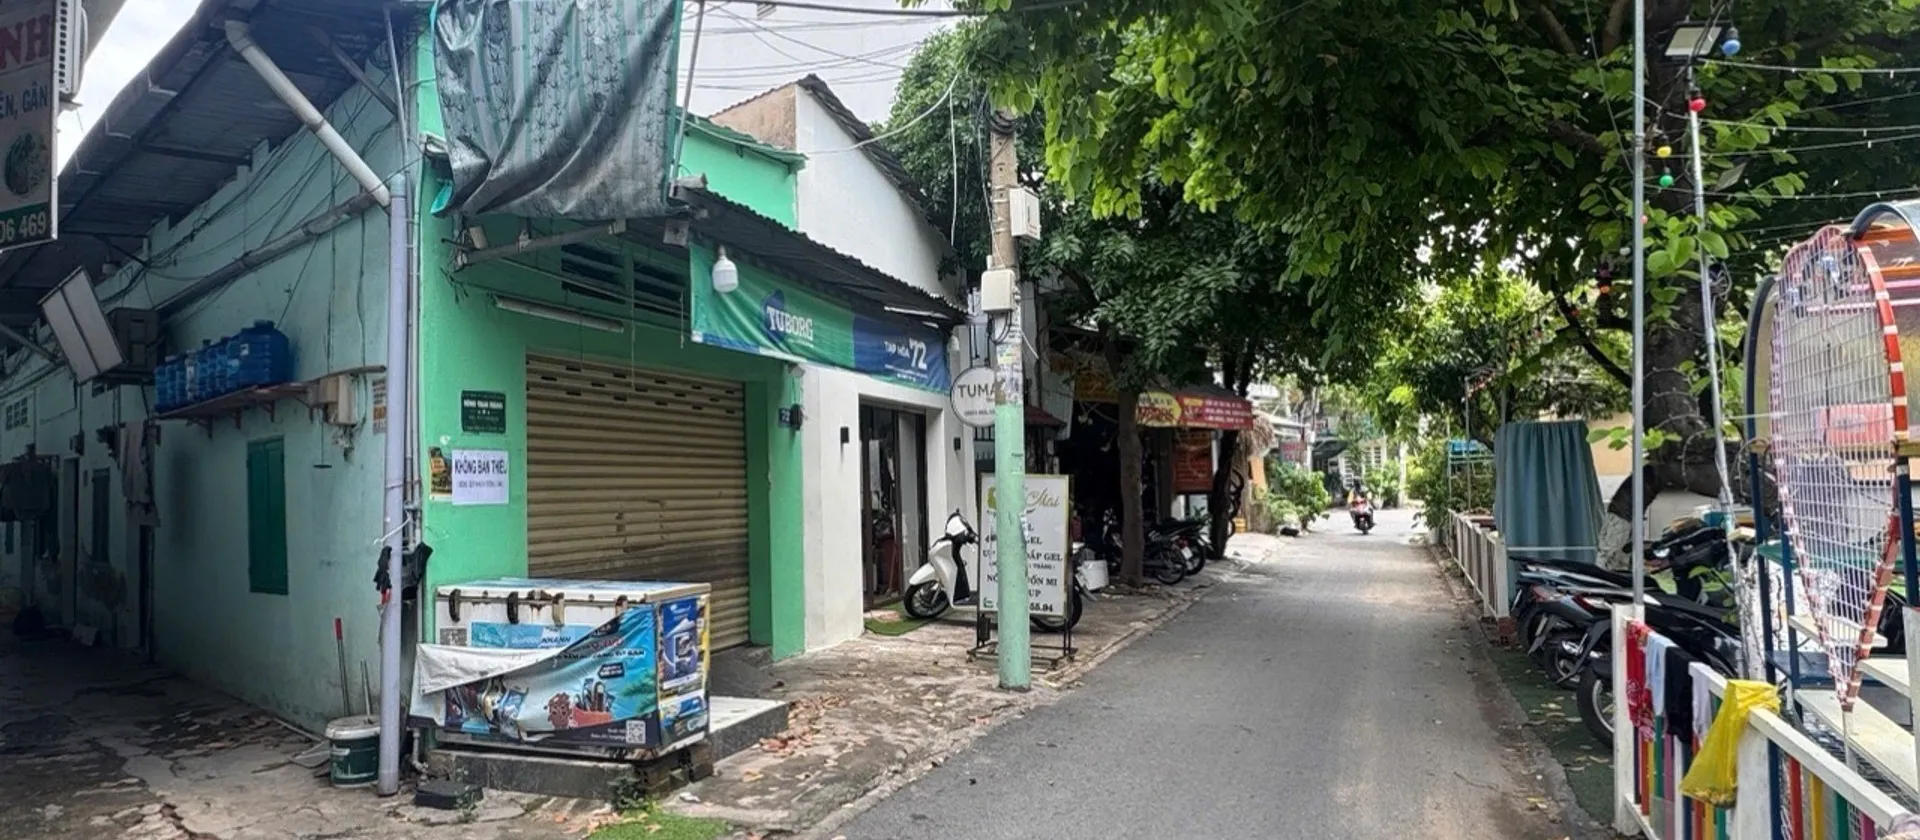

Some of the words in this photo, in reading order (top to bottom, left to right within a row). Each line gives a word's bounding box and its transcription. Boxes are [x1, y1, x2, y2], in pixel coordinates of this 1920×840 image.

[19, 211, 46, 238] 469
[766, 305, 814, 341] TUBORG
[909, 338, 927, 370] 72
[1044, 552, 1063, 562] GEL
[1046, 577, 1057, 586] MI
